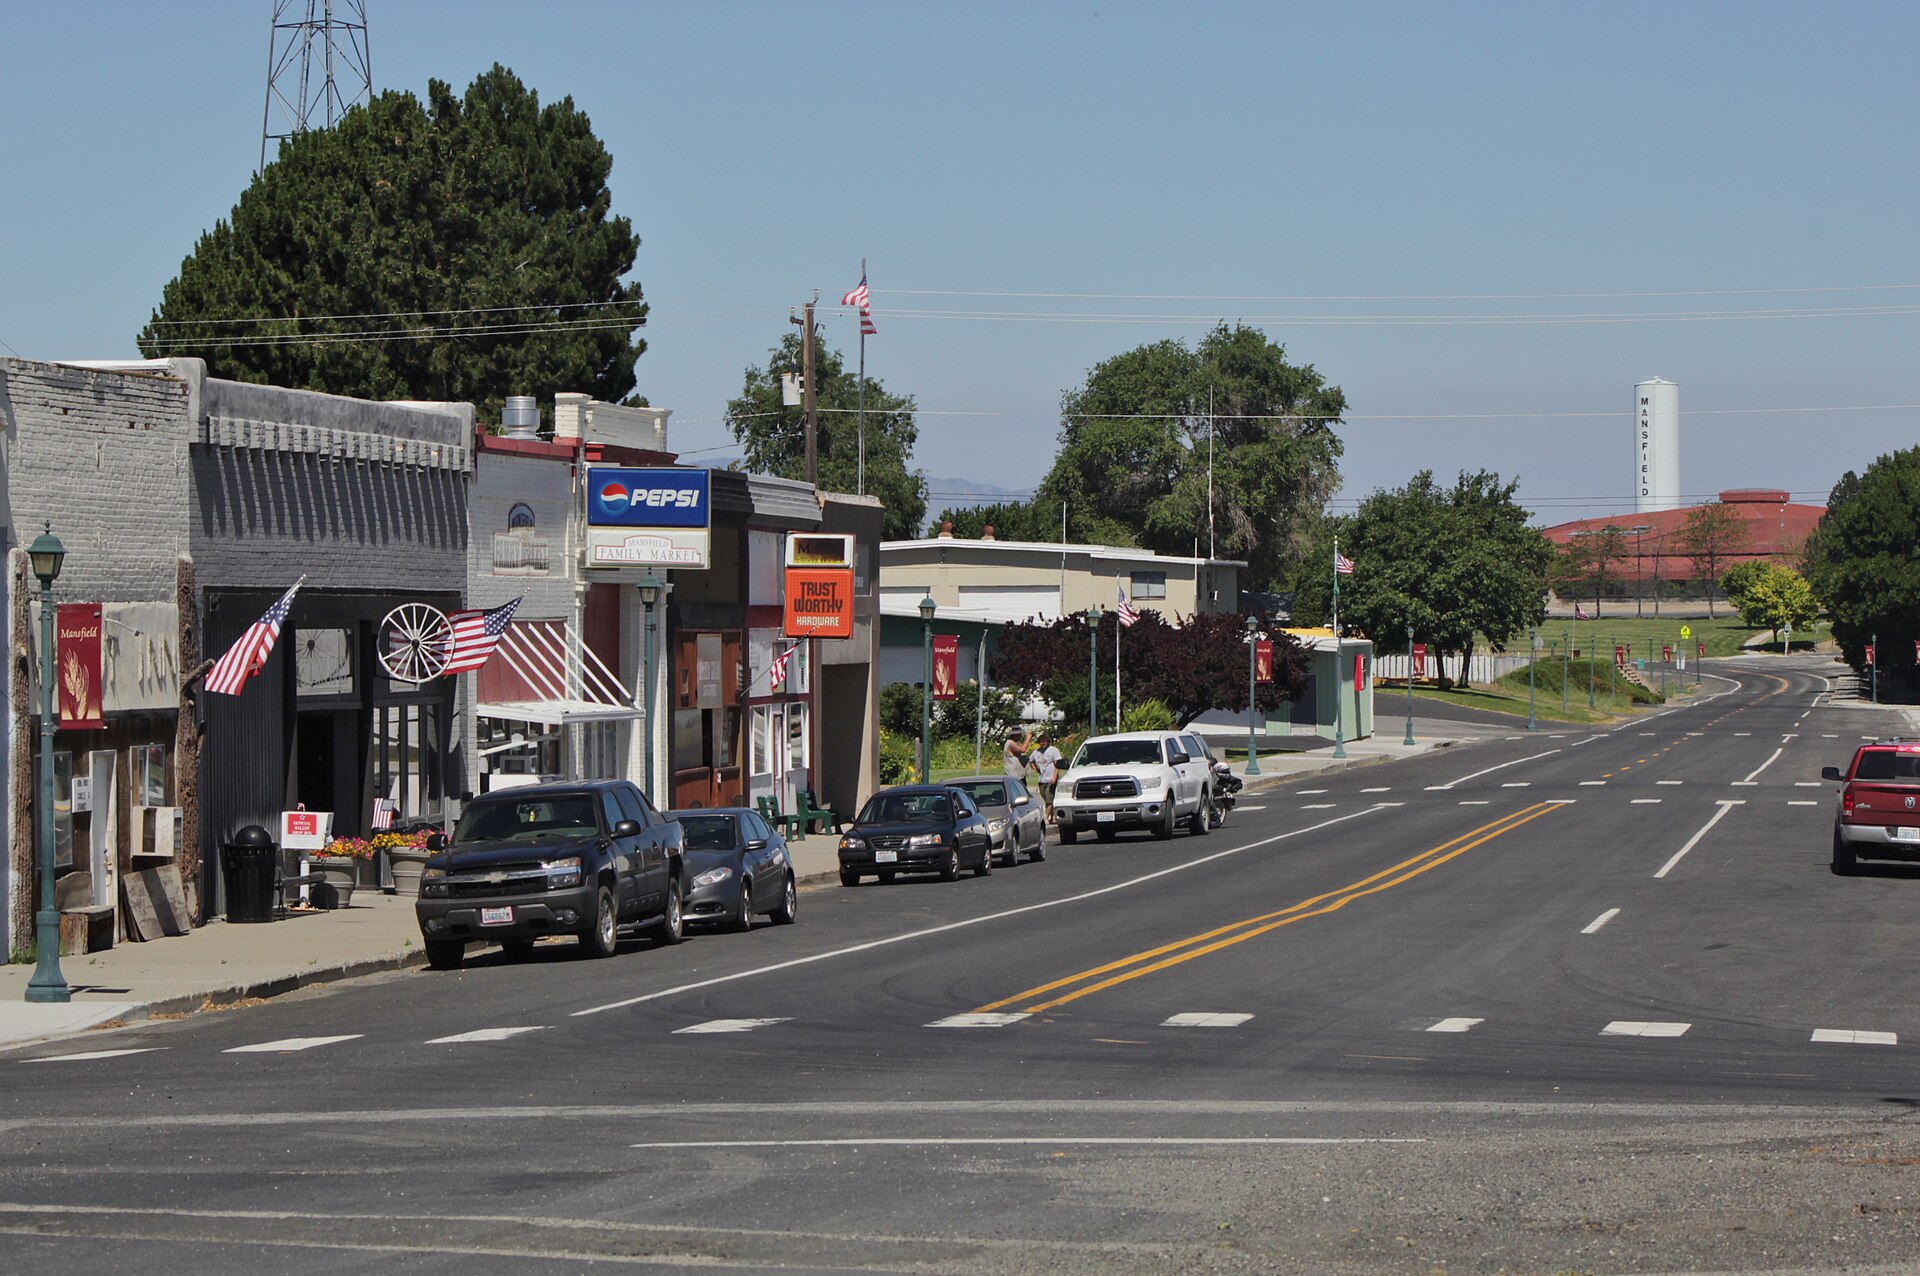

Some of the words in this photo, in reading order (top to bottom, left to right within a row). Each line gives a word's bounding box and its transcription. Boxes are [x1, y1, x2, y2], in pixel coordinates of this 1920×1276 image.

[1640, 397, 1649, 496] MANSFIELD
[630, 489, 699, 507] PEPSI
[600, 548, 642, 559] FAMILY
[650, 549, 695, 561] MARKET
[800, 582, 837, 599] TRUST
[794, 599, 843, 613] WORTHY
[796, 616, 839, 627] HARDWARE
[61, 626, 98, 642] Mansfield
